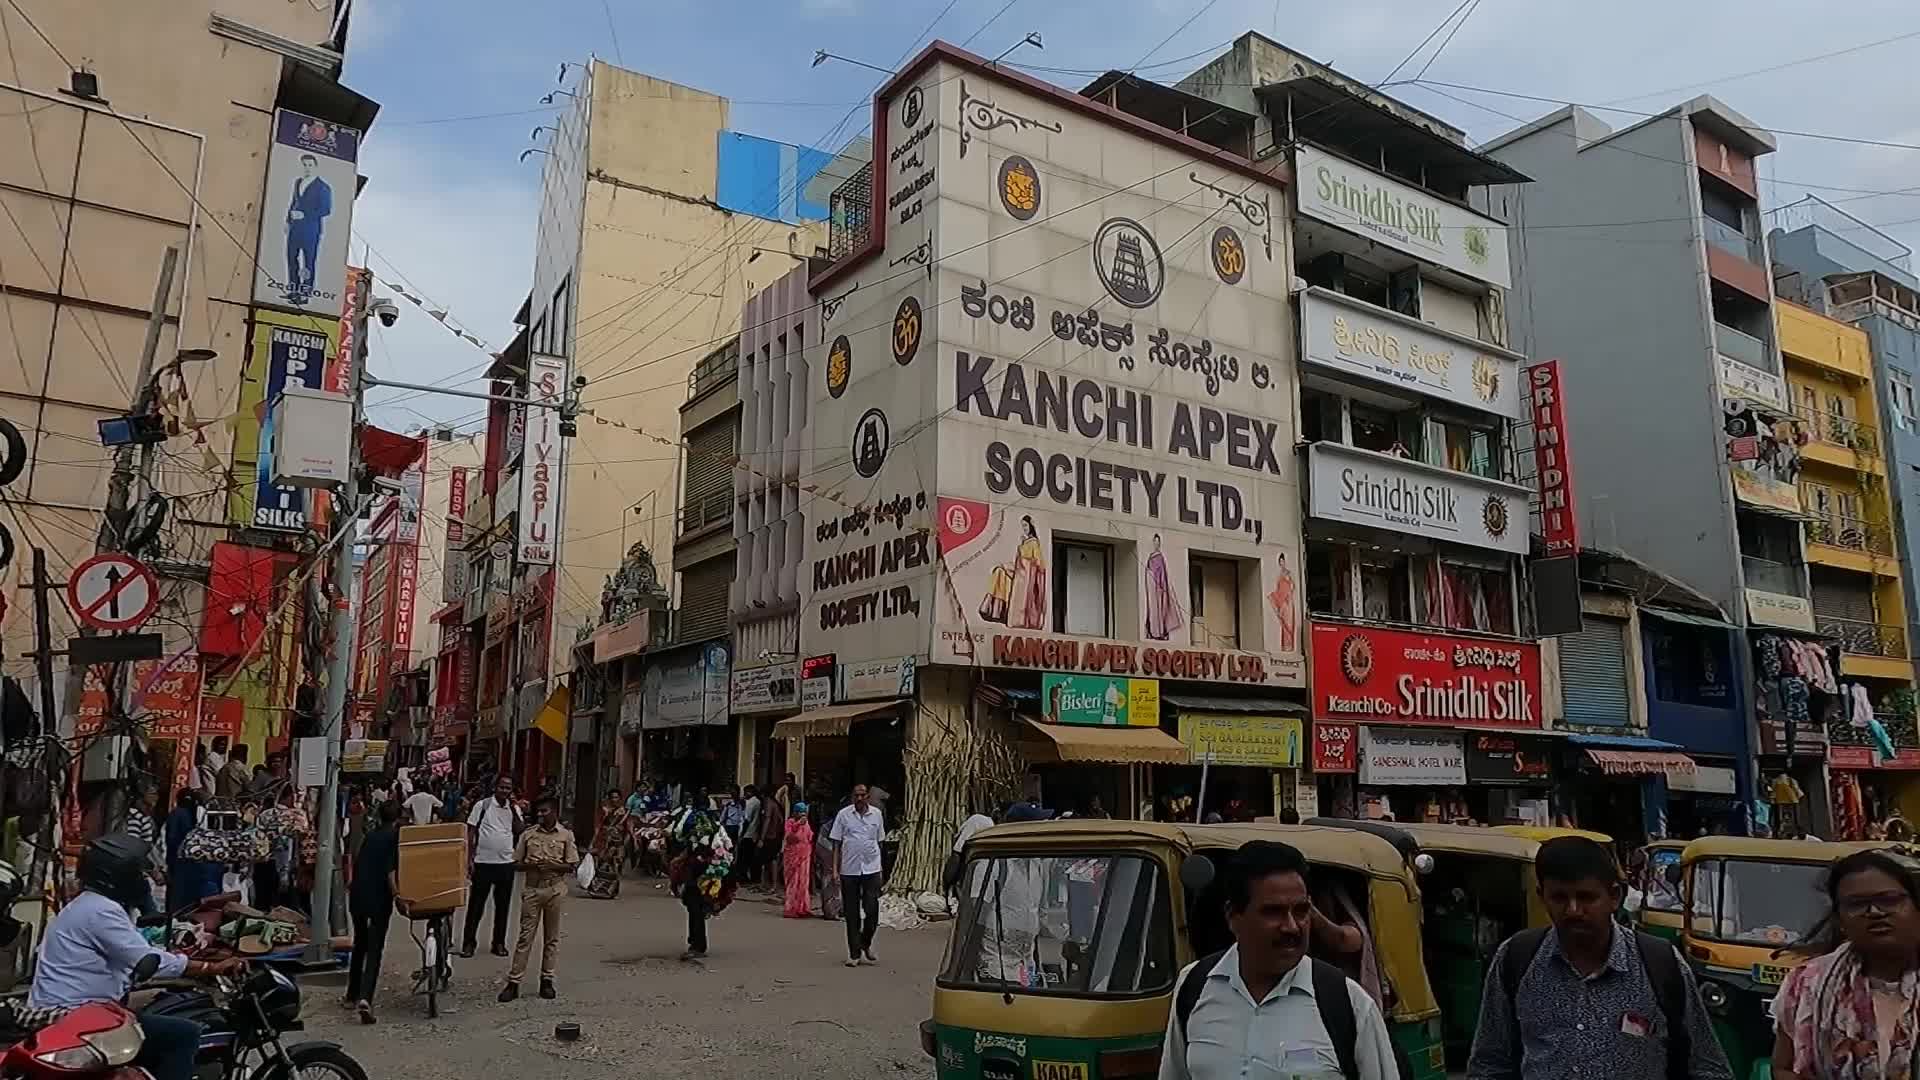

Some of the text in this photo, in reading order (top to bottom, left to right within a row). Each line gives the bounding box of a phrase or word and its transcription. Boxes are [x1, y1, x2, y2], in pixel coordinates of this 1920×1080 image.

[1317, 166, 1444, 247] Srinidhi Silk
[274, 331, 324, 350] KANCHI
[288, 346, 308, 359] CO
[956, 350, 1281, 475] KANCHI APEX
[1533, 366, 1565, 532] SRINIDHI
[984, 440, 1166, 519] SOCIETY
[1341, 468, 1458, 524] Srinidhi Silk
[256, 507, 305, 529] SILKS
[813, 544, 877, 592] KANCHI
[880, 531, 930, 575] APEX
[820, 592, 880, 631] SOCIETY
[993, 634, 1079, 669] KANCHI
[1081, 642, 1137, 675] APEX
[1142, 647, 1225, 680] SOCIETY
[1328, 695, 1374, 714] Kaanchi
[1399, 673, 1490, 719] Srinidhi
[1493, 679, 1534, 721] Silk
